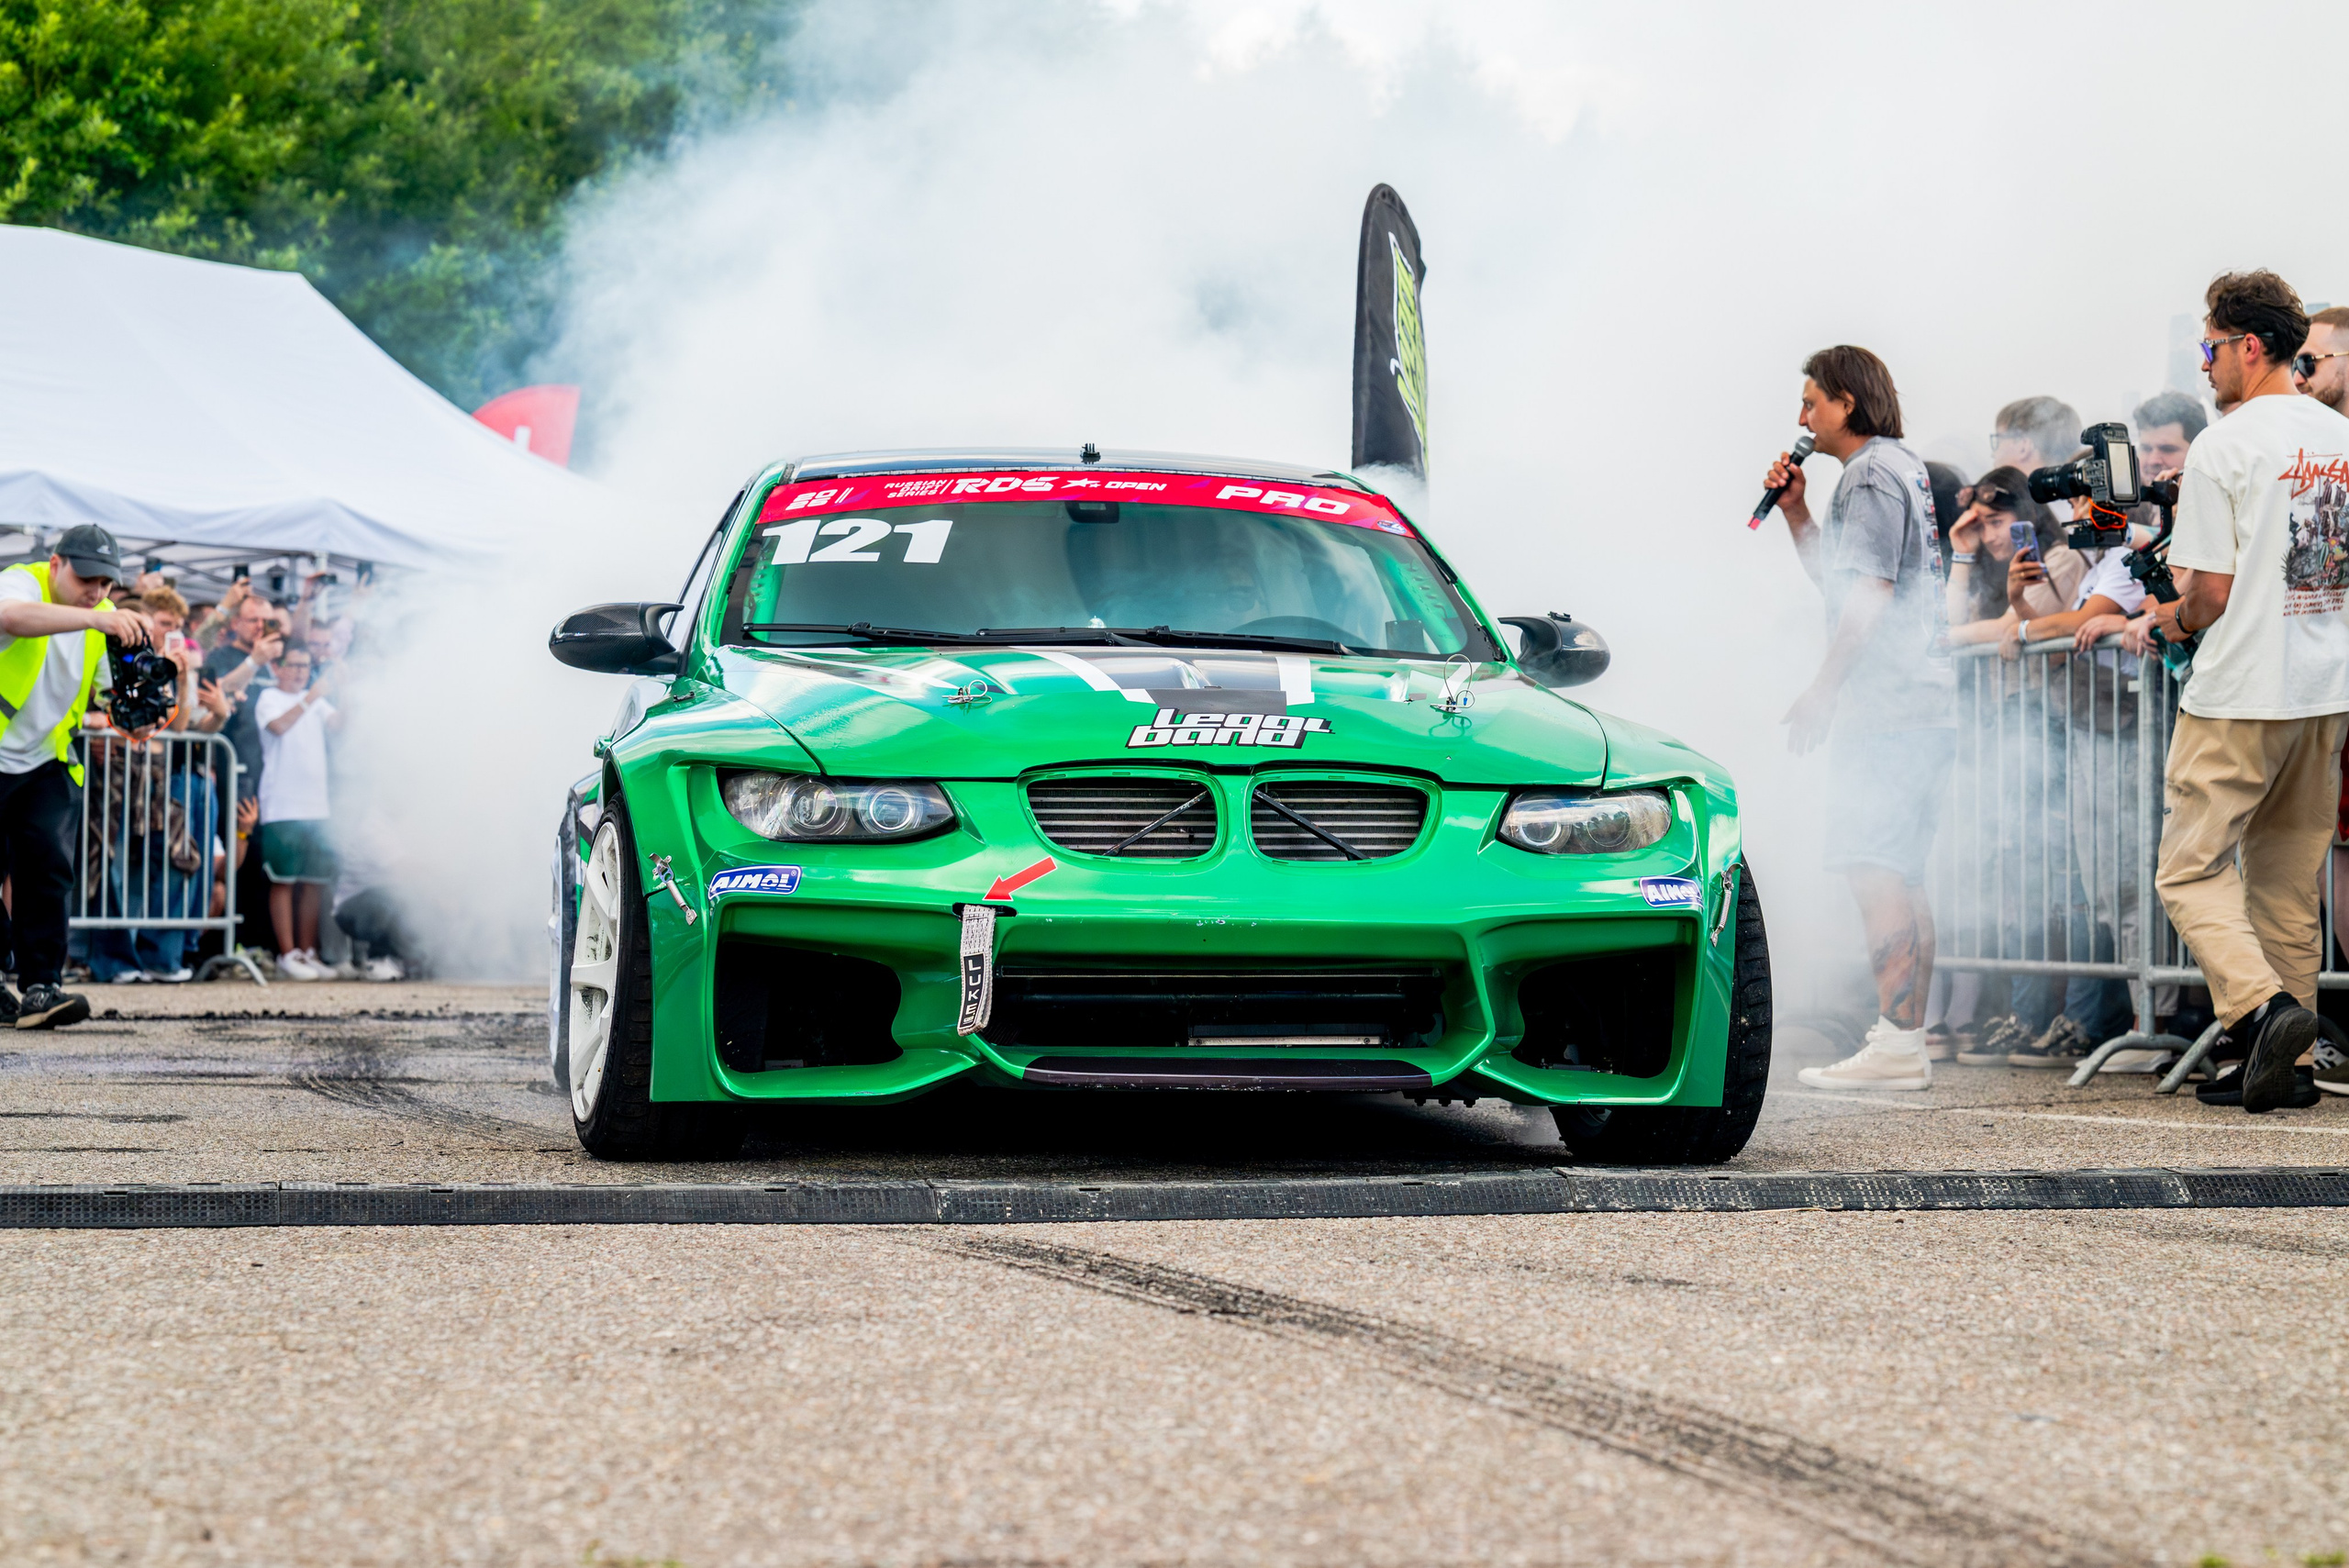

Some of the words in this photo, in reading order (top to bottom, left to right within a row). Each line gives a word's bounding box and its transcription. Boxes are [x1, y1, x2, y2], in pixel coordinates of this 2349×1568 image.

[884, 479, 947, 489] RUSSIAN
[899, 484, 942, 493] DRIFT
[951, 476, 1060, 495] RDS
[1104, 481, 1167, 492] OPEN
[886, 489, 938, 498] SERIES
[1216, 485, 1351, 515] PRO
[762, 517, 953, 565] 121
